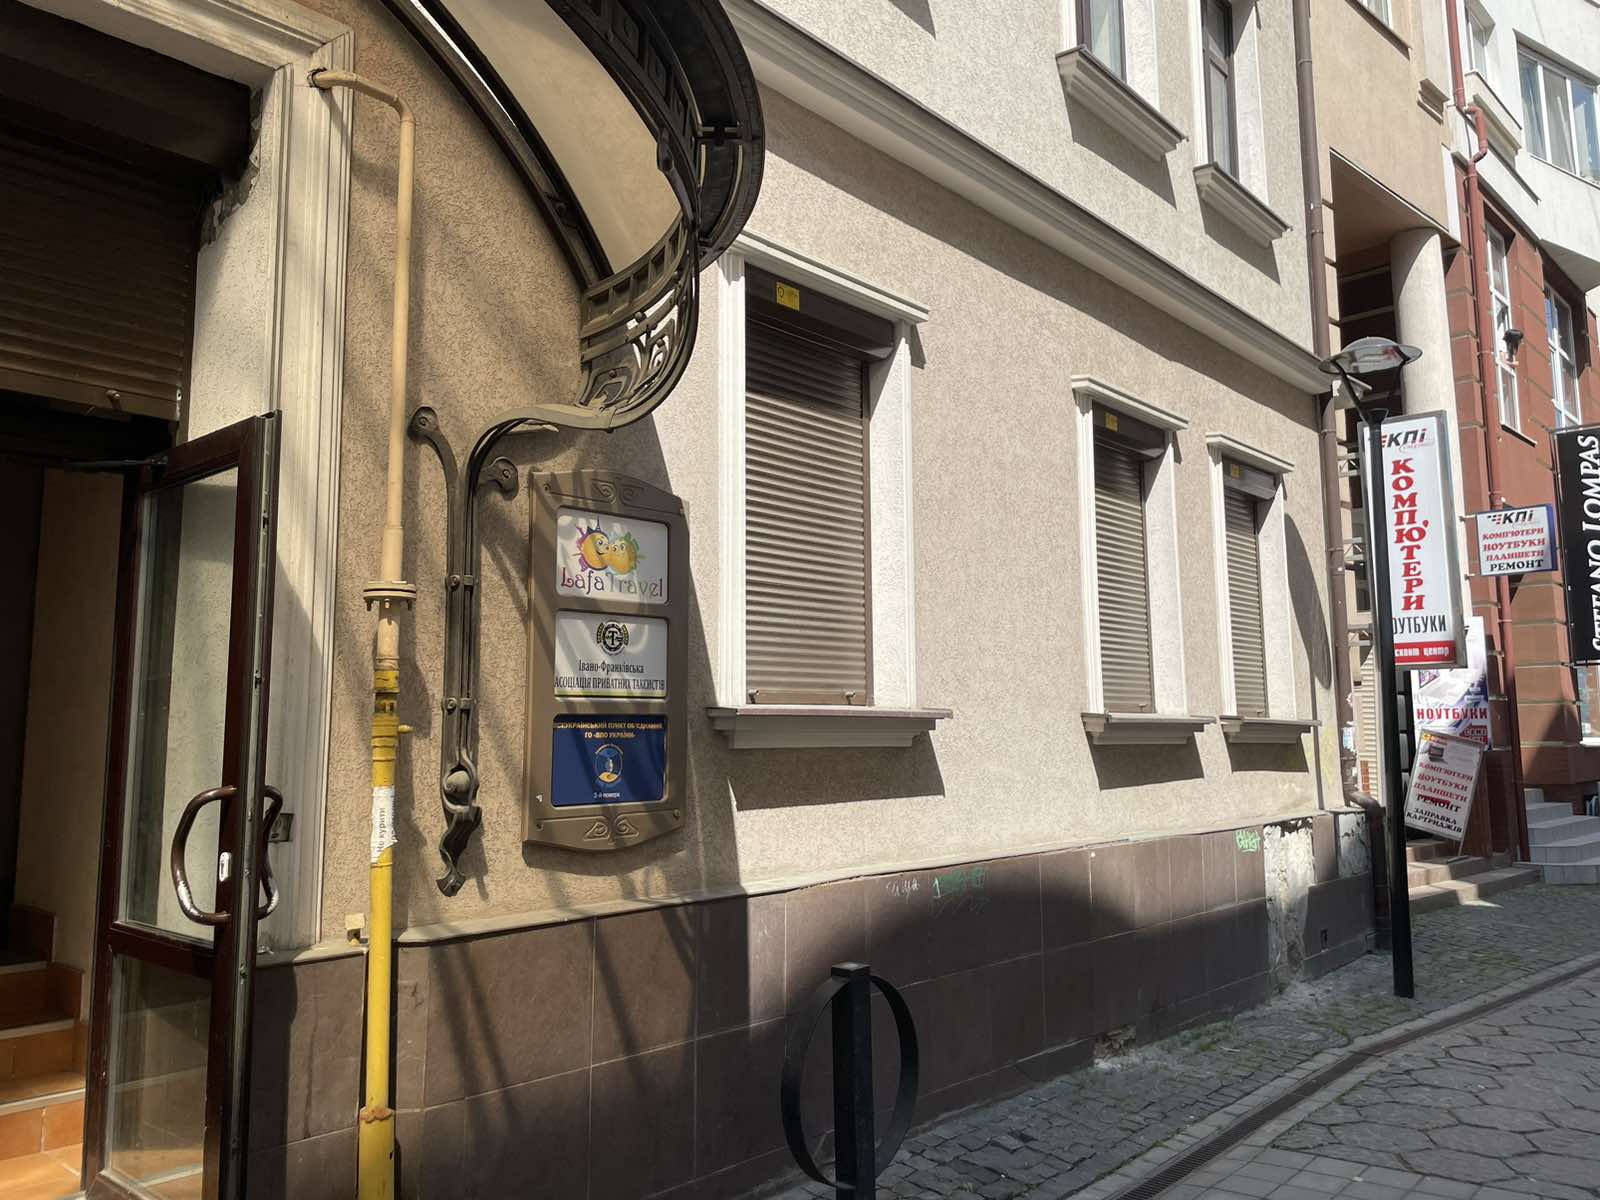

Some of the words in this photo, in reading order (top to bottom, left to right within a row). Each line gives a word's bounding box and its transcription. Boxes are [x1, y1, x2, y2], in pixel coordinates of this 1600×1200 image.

[1482, 538, 1545, 552] НОУТБУКИ
[1486, 550, 1544, 561] ПЛАНШЕТИ
[1489, 559, 1543, 572] РЕМОНТ
[1392, 615, 1447, 635] ОУТБУКИ
[578, 660, 645, 676] Івано-Франківська
[554, 675, 591, 691] АСОЦІАЦІЯ
[592, 676, 631, 690] ПРИВАТНИХ
[1416, 707, 1488, 720] НОУТБУКИ
[1413, 783, 1469, 802] ПЛАНШЕТИ
